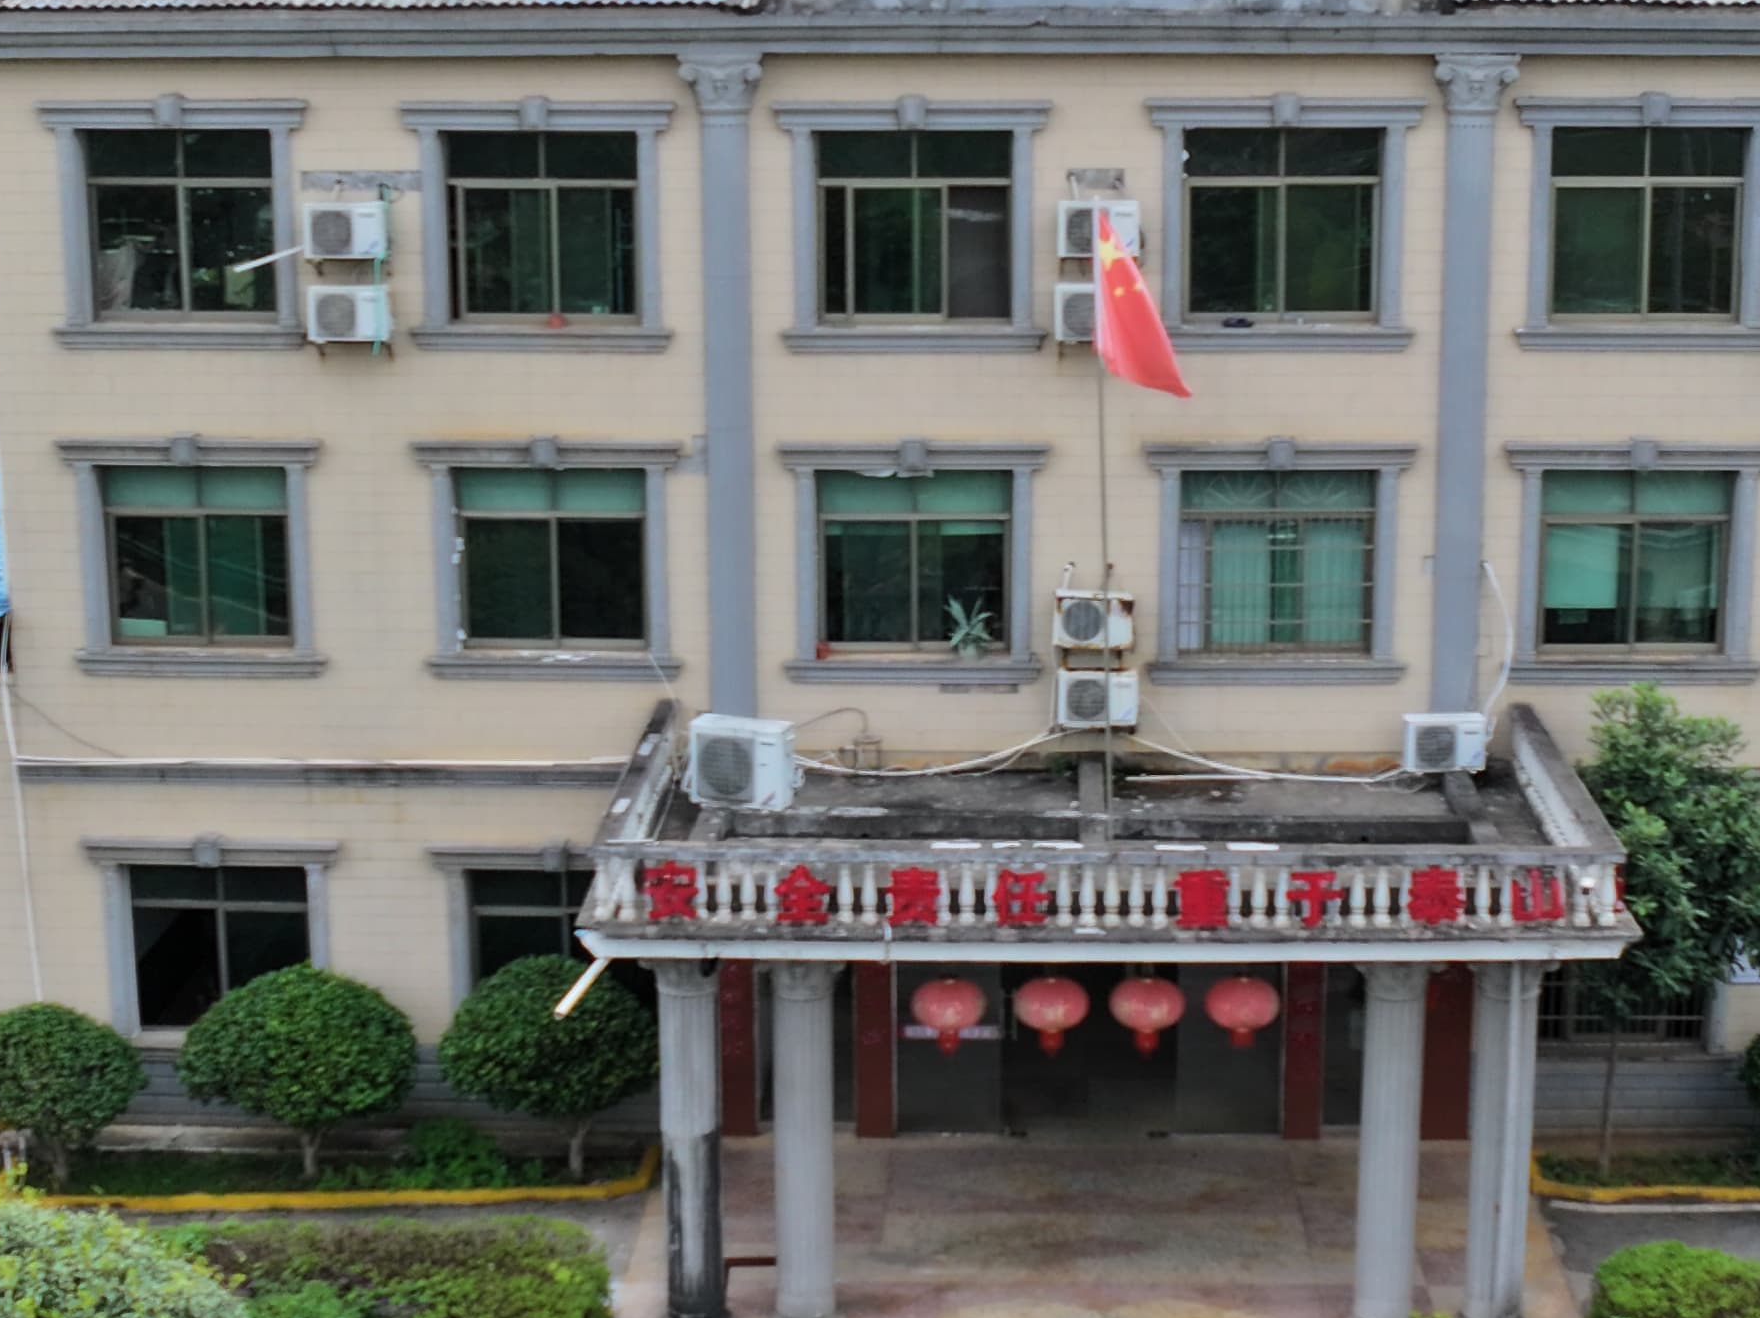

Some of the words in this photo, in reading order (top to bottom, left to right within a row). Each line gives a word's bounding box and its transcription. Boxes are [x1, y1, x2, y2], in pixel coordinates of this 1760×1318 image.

[642, 859, 1567, 929] 安全责任重于泰山
